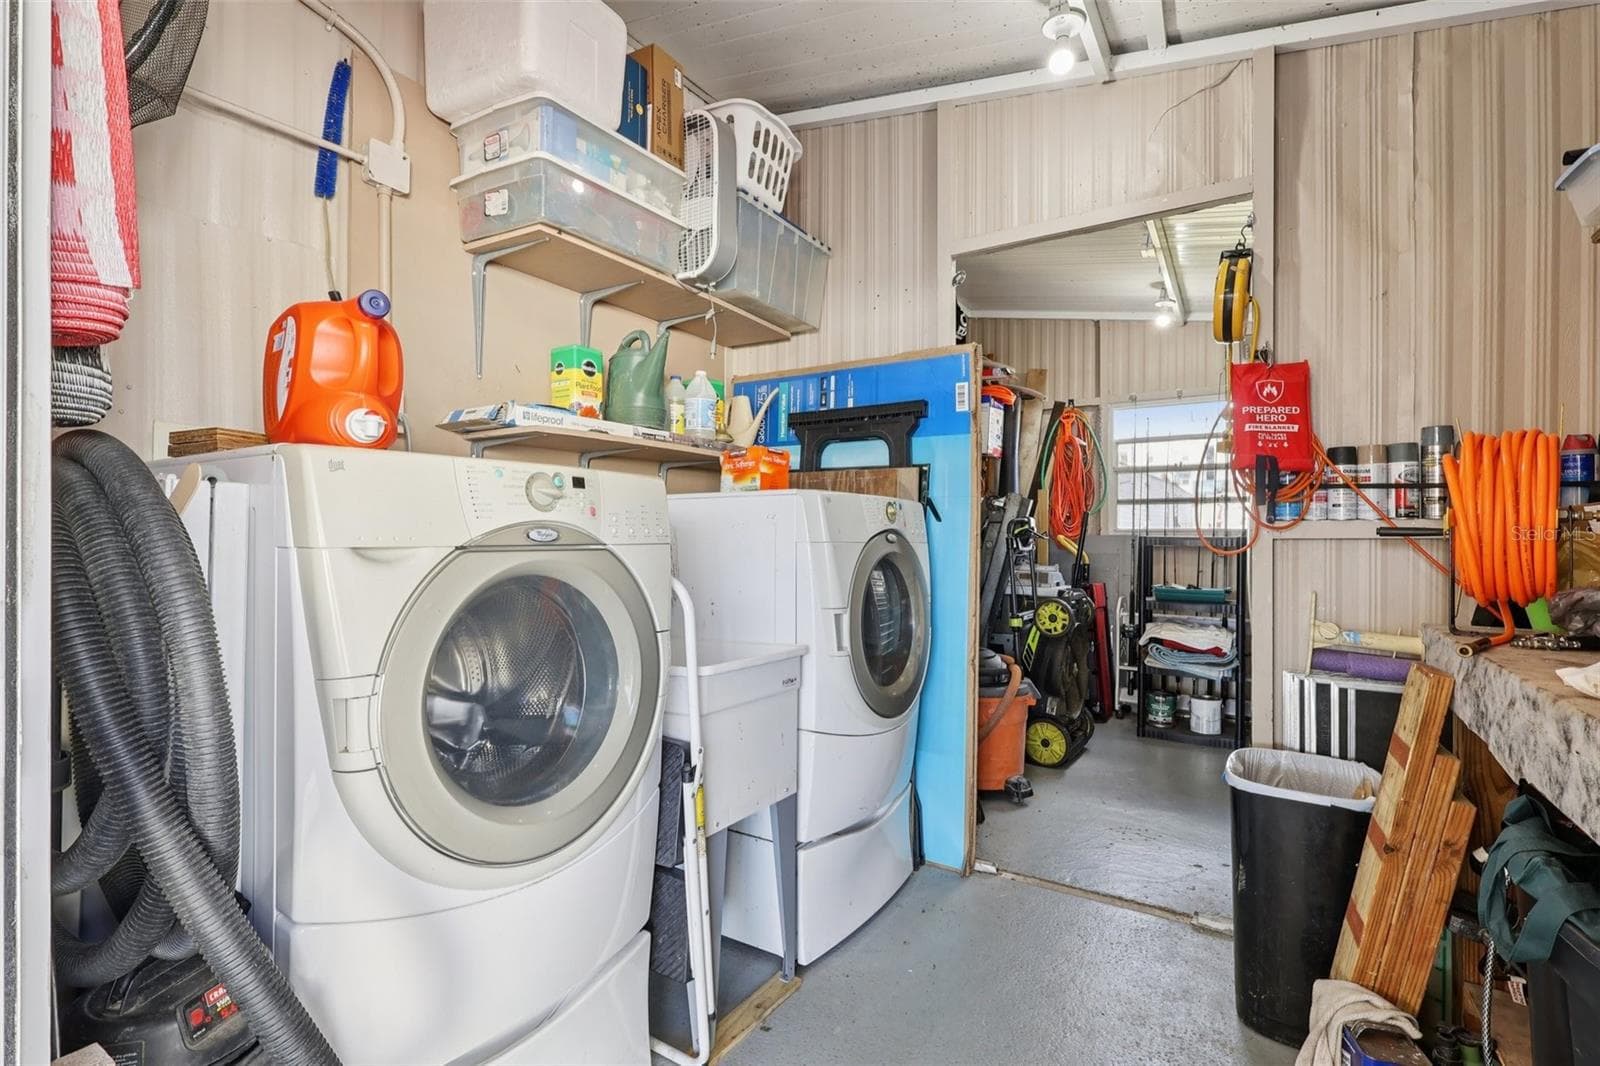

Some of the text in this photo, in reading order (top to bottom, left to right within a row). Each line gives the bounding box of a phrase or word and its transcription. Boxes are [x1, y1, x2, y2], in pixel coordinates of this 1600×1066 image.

[660, 78, 668, 135] CHARGER
[1242, 406, 1300, 414] PREPARED
[530, 412, 564, 426] lifeproof
[1256, 414, 1287, 422] HERO
[209, 987, 227, 1001] CRA
